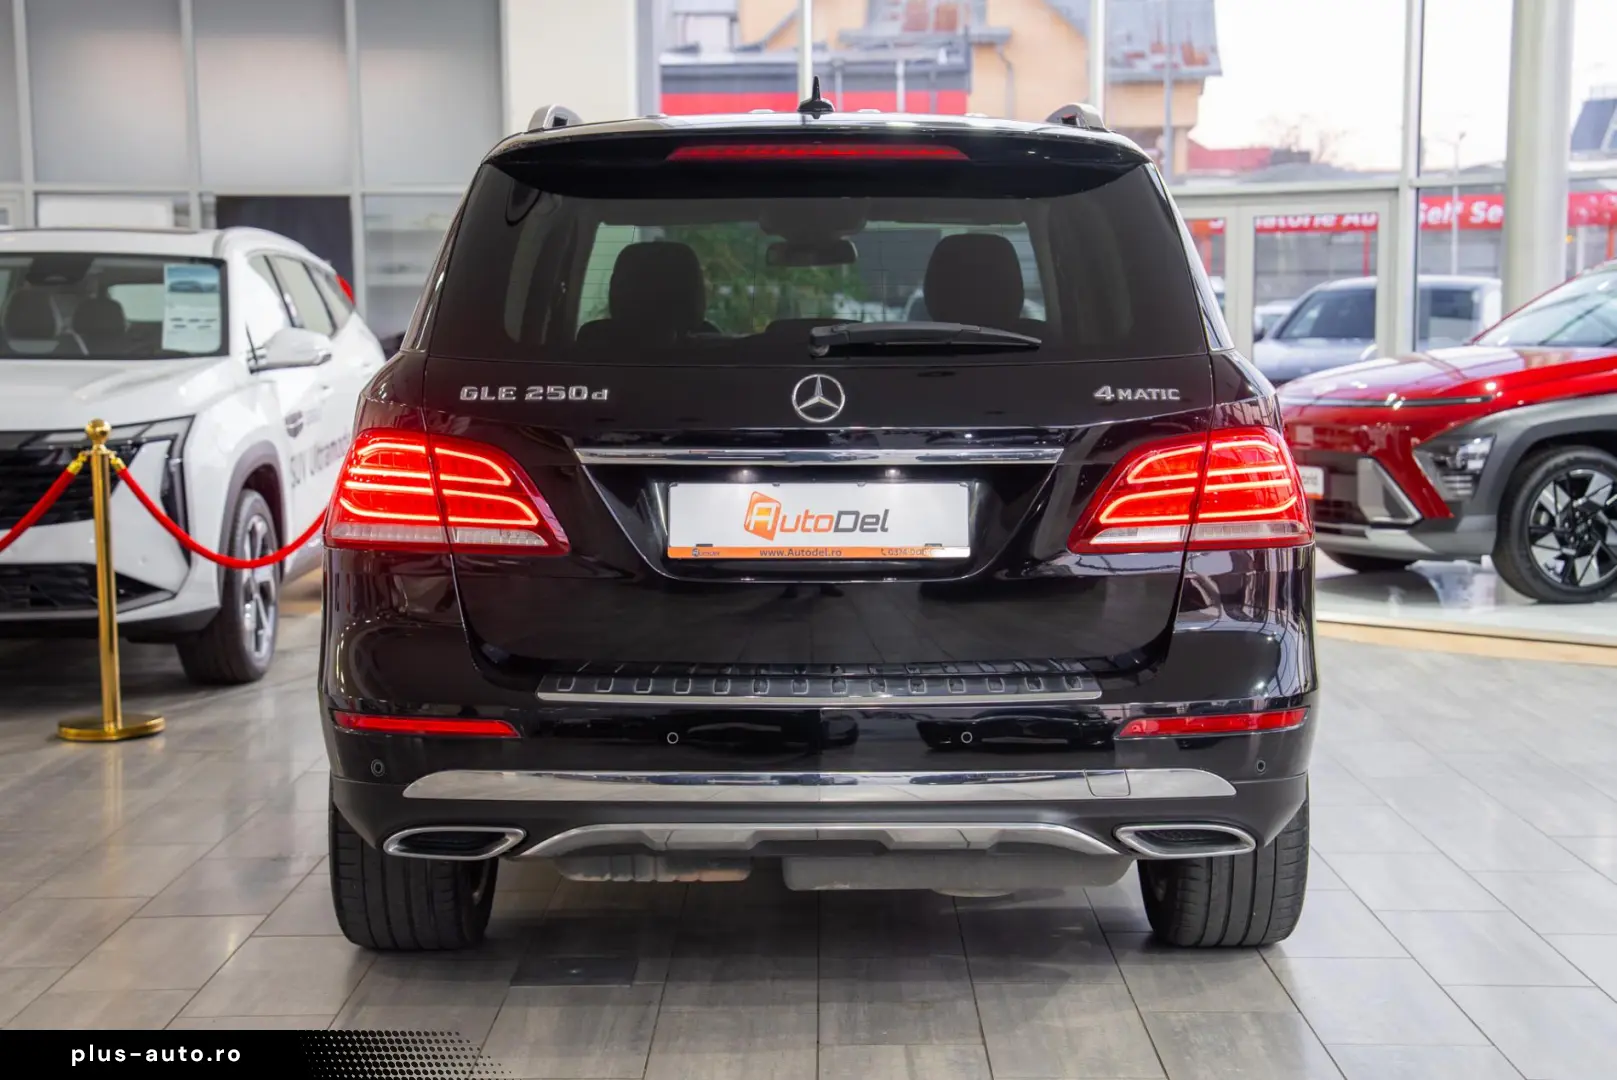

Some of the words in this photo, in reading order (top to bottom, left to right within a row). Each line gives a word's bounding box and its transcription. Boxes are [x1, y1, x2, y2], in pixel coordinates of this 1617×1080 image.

[459, 386, 517, 401] GLE
[744, 490, 890, 541] AutoDel
[759, 548, 842, 557] www.Autodel.ro
